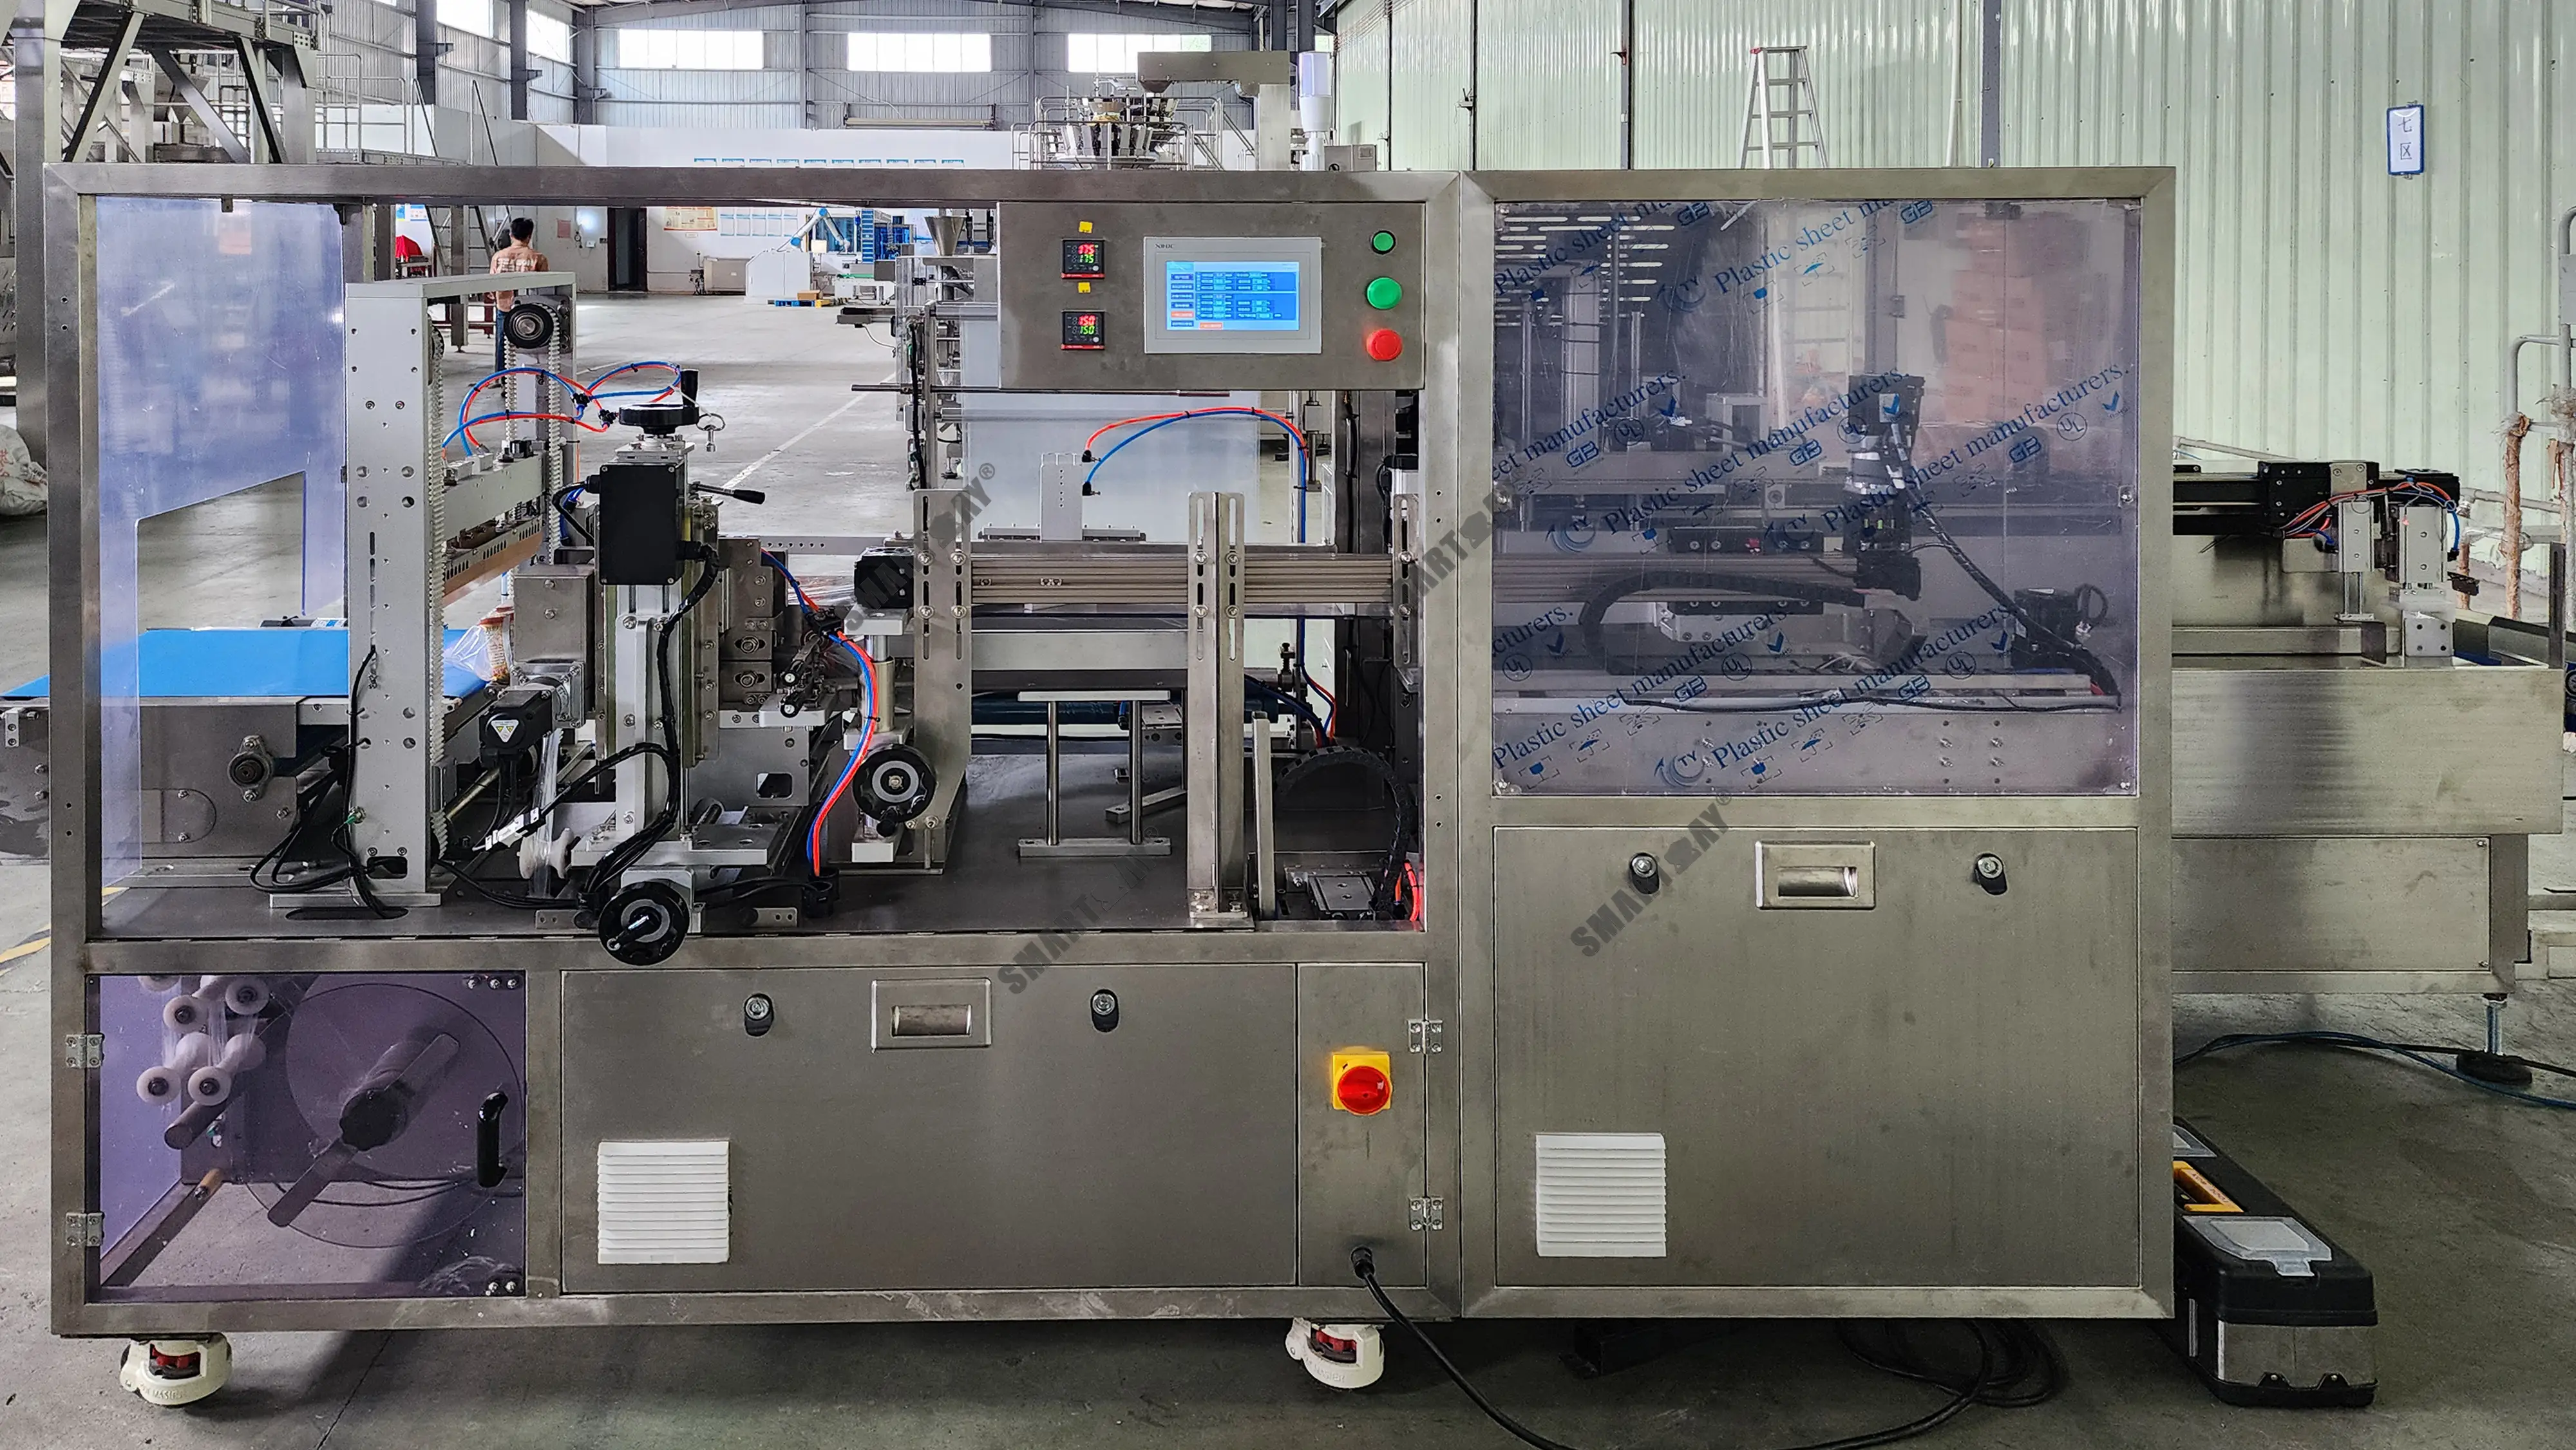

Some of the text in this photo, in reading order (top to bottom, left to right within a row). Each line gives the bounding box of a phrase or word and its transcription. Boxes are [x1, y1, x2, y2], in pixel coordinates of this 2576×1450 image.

[2398, 117, 2412, 160] 七区
[1495, 246, 1569, 296] Plastic
[1571, 211, 1628, 254] sheet
[1714, 244, 1792, 294] Plastic
[1795, 210, 1855, 251] sheet
[1079, 325, 1095, 335] 150
[1524, 370, 1686, 462] manufacturers.
[1603, 368, 1909, 535] Plastic sheet manufacturers.
[1903, 447, 1963, 490] sheet
[1965, 362, 2130, 458] manufacturers.
[1492, 720, 1567, 769] Plastic
[1570, 686, 1629, 729] sheet
[1678, 751, 1698, 767] TY
[1711, 720, 1790, 770] Plastic
